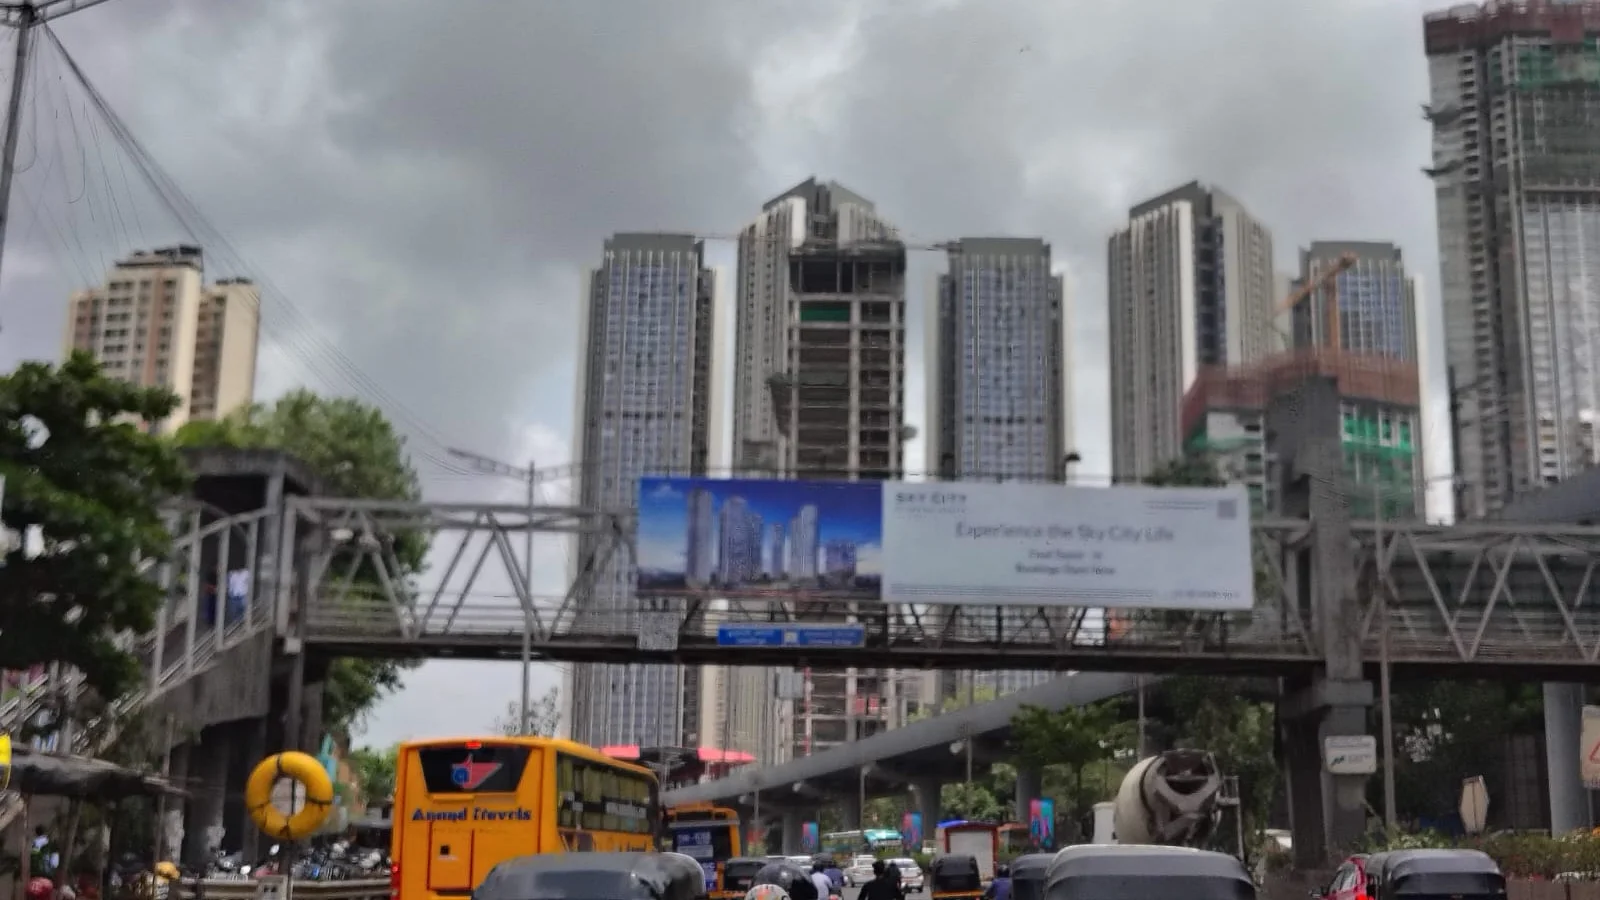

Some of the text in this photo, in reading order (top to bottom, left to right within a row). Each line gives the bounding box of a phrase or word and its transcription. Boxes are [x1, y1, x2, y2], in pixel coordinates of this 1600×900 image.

[896, 492, 967, 504] SKY CITY
[955, 521, 1174, 543] Experience the Sky City Life
[473, 806, 532, 821] Travels
